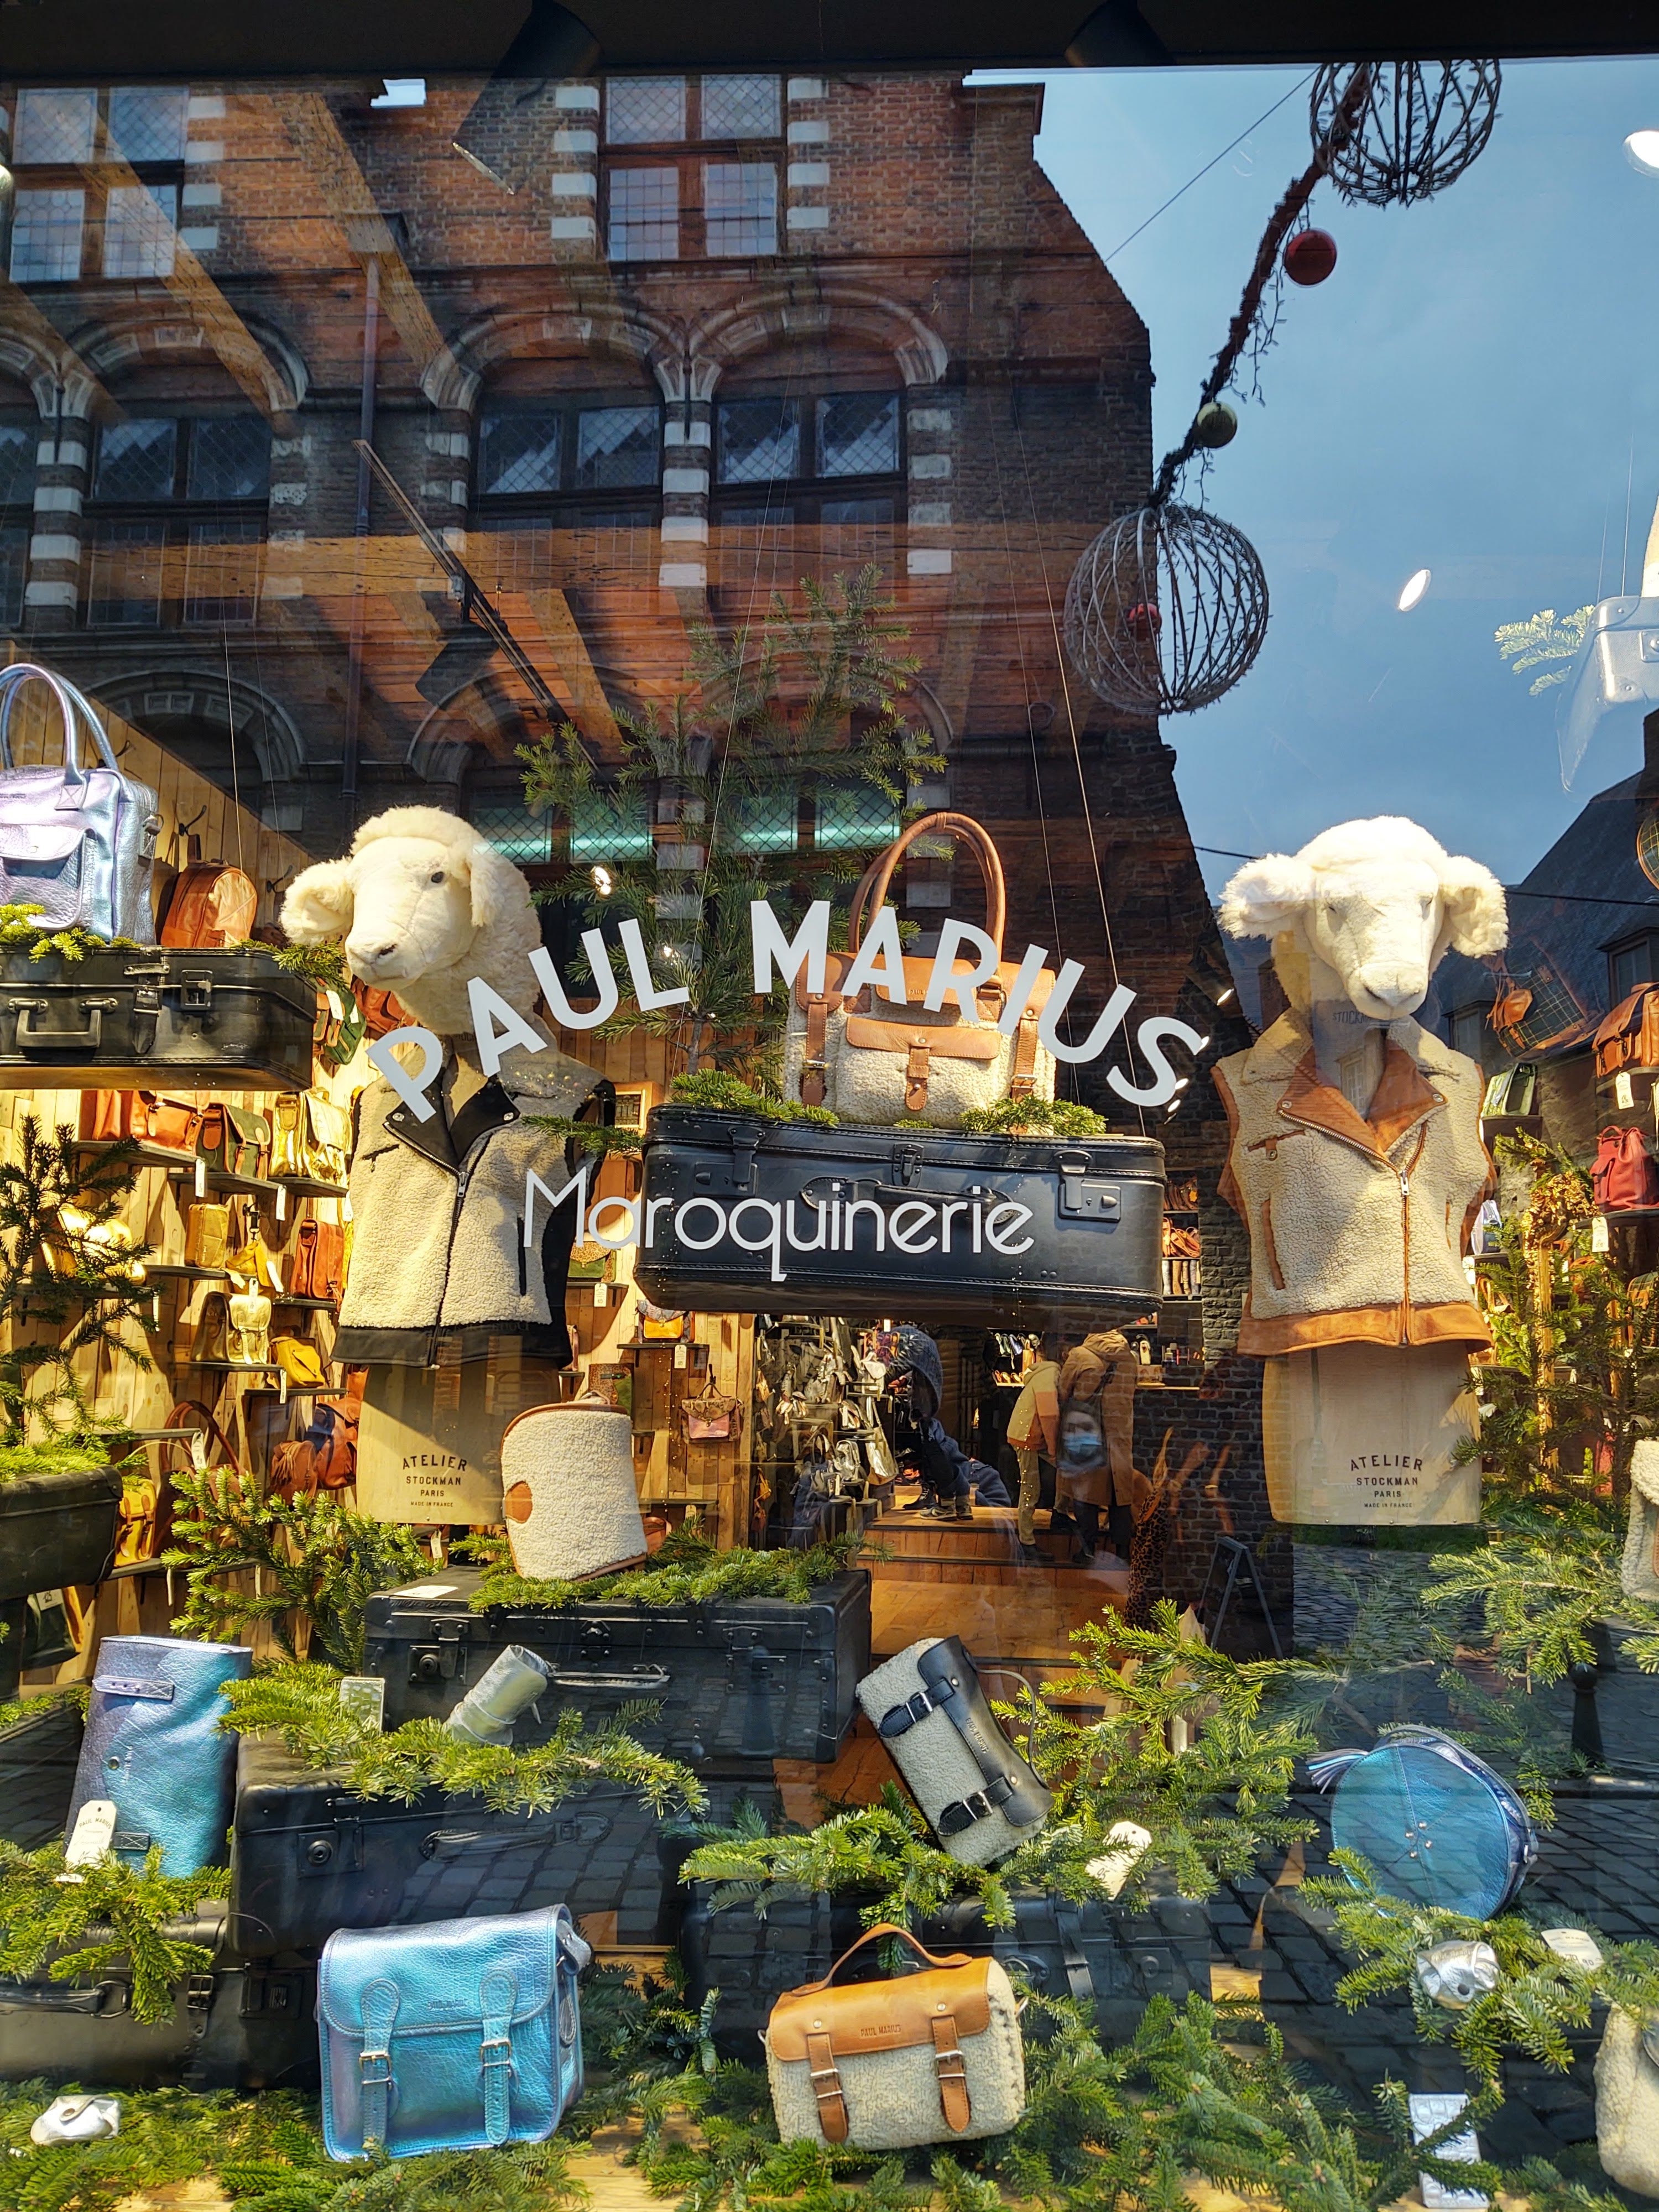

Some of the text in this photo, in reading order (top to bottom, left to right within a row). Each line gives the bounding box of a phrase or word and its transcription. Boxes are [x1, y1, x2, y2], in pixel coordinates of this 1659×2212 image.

[367, 900, 1203, 1124] PAUL MARIUS
[523, 1166, 1035, 1281] Maroquinerie
[403, 1454, 467, 1472] ATELIER
[1351, 1454, 1422, 1471] ATELIER
[406, 1476, 461, 1486] STOCKMAN
[1357, 1477, 1418, 1486] STOCKMAN
[79, 1817, 112, 1829] PAUL MARIUS
[860, 2024, 901, 2037] PAUL MARIUS
